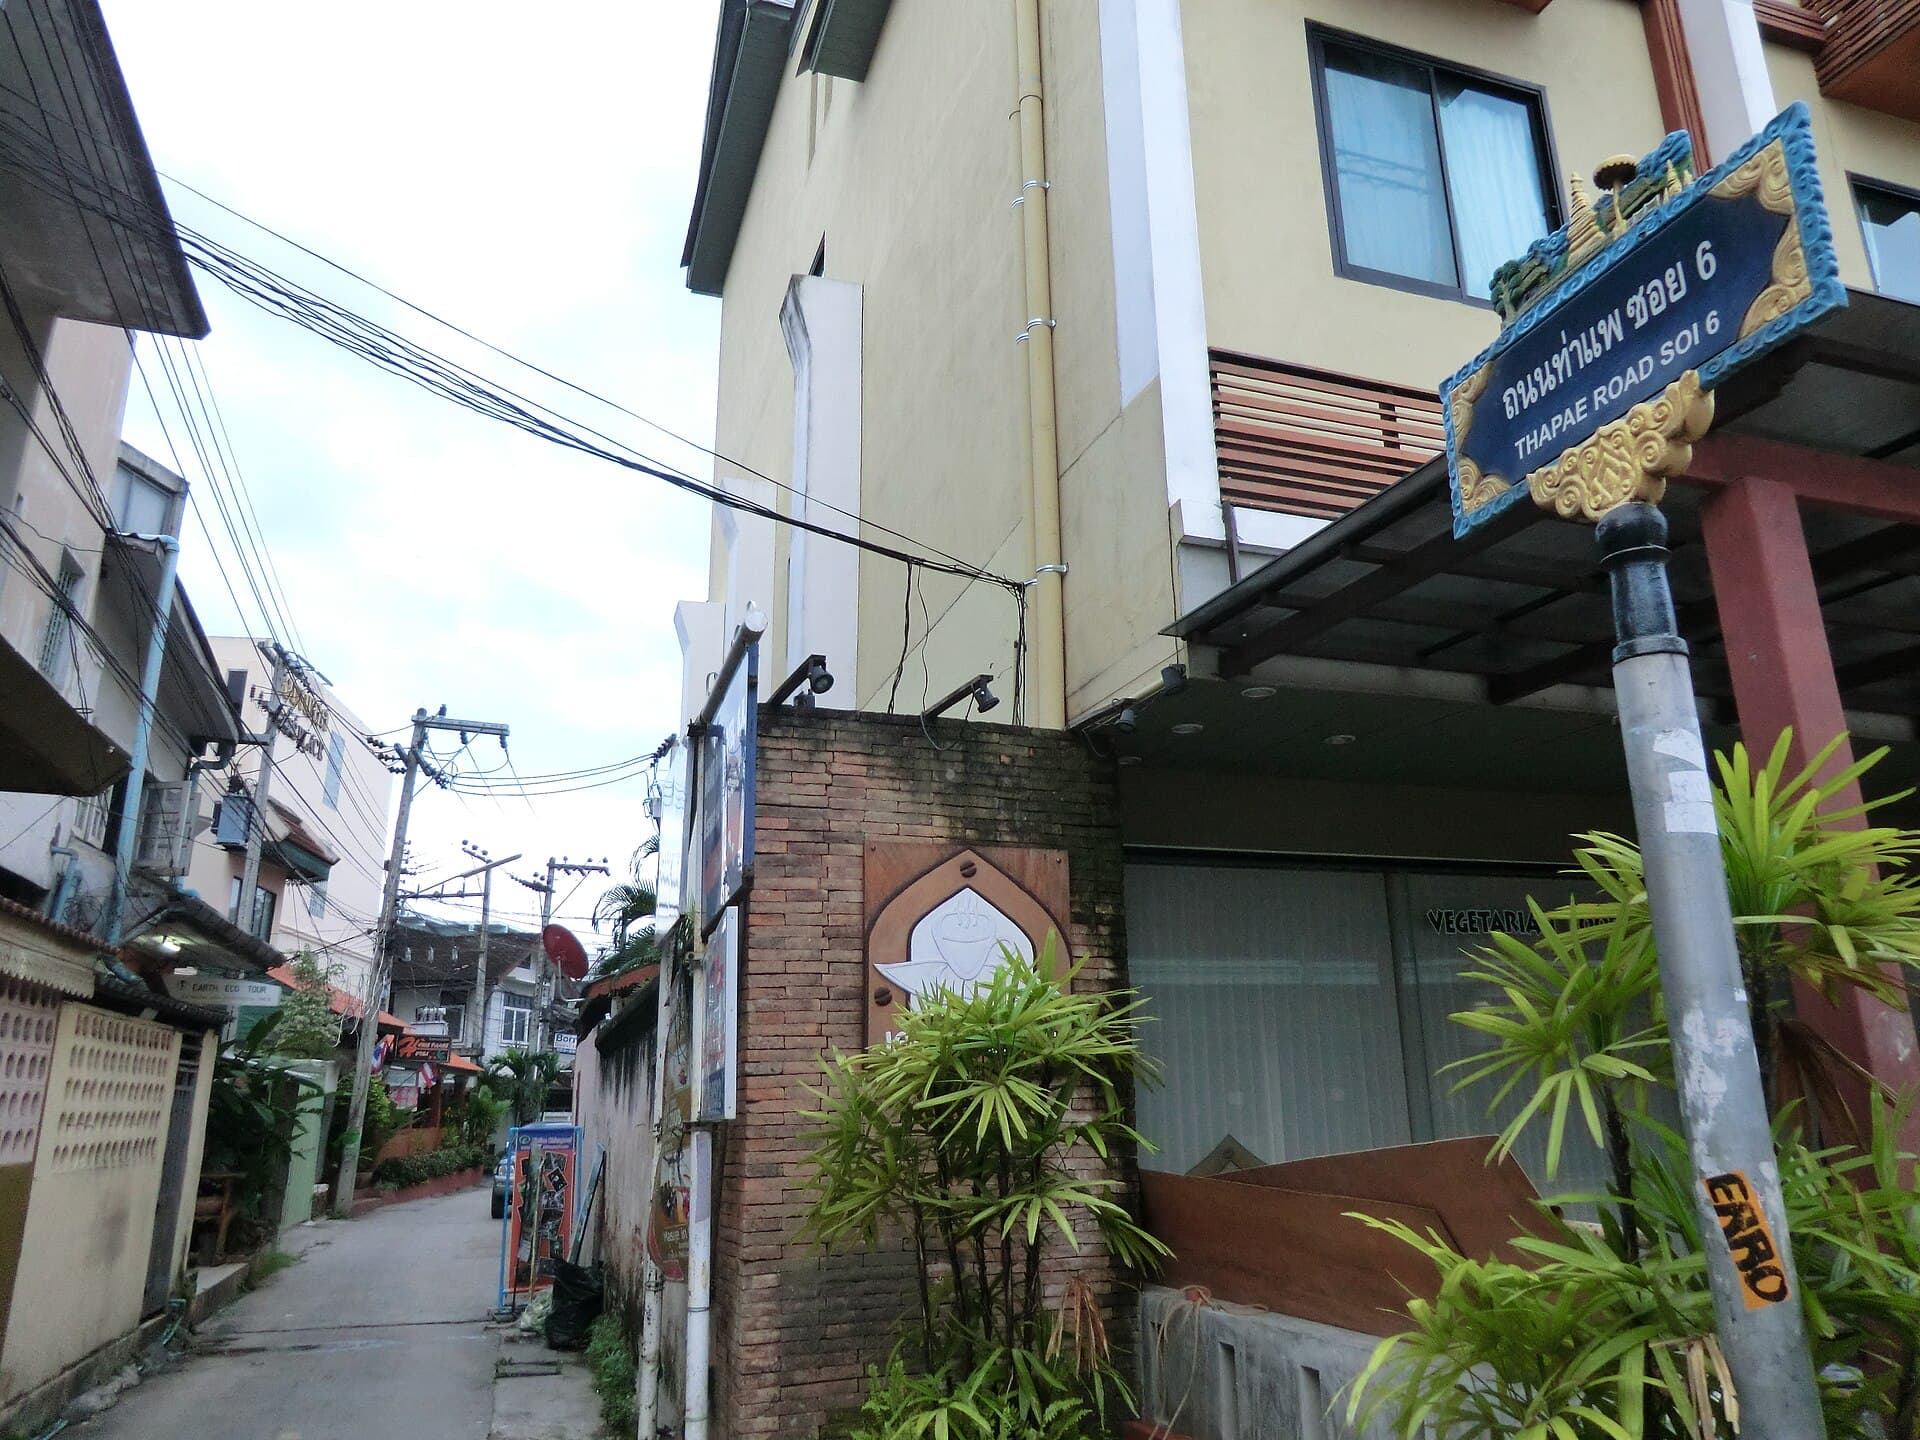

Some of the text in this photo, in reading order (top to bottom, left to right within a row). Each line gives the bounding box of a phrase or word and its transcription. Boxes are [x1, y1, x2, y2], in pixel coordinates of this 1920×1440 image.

[1502, 240, 1717, 420] ถนนท่าแพ ซอย 6
[1514, 310, 1720, 460] THAPAE ROAD SOI 6
[1427, 908, 1557, 936] VEGETARIA
[192, 983, 267, 994] EARTH ECO TOUR
